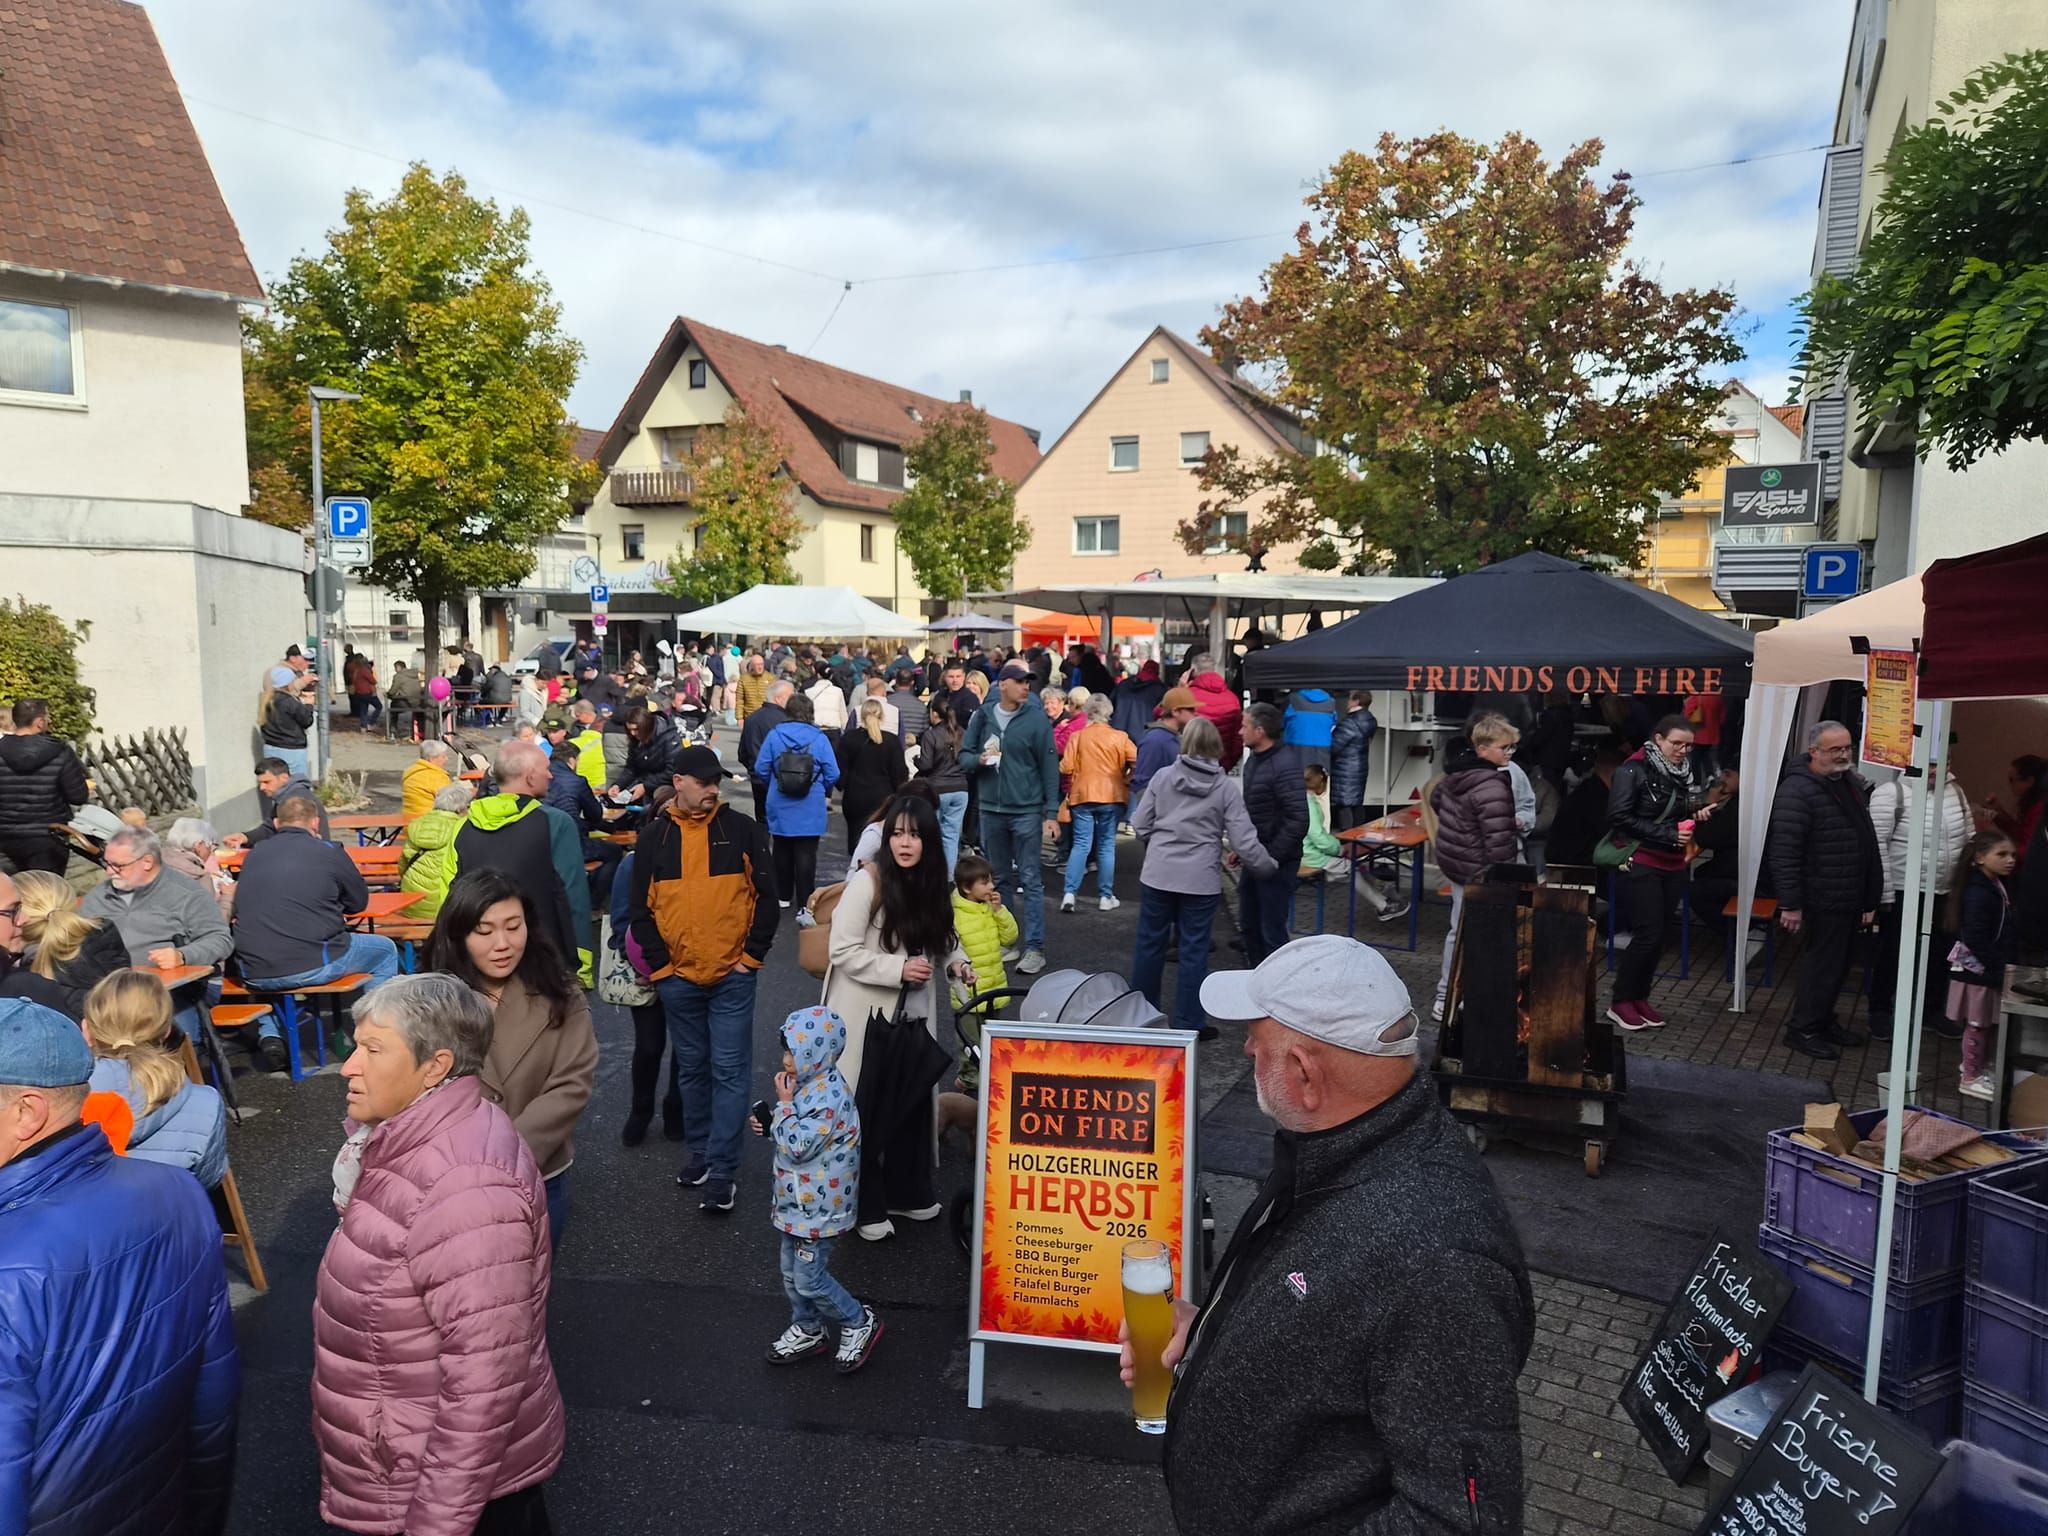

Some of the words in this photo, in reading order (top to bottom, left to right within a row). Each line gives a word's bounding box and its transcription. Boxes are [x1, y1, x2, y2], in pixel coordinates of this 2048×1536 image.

[1732, 488, 1808, 513] EASY
[1756, 503, 1806, 519] Sports
[338, 505, 359, 533] P
[1817, 555, 1847, 590] P
[594, 587, 605, 601] P
[1405, 665, 1554, 694] FRIENDS
[1566, 665, 1621, 695] ON
[1634, 667, 1725, 695] FIRE
[1020, 1085, 1151, 1114] FRIENDS
[1019, 1112, 1065, 1136] ON
[1076, 1116, 1149, 1142] FIRE
[1008, 1153, 1159, 1180] HOLZGERLINGER
[1008, 1174, 1160, 1231] HERBST
[1015, 1221, 1064, 1235] Pommes
[1106, 1222, 1147, 1238] 2026
[1015, 1235, 1094, 1252] Cheeseburger
[1015, 1250, 1040, 1262] BBQ
[1043, 1252, 1081, 1266] Burger
[1014, 1263, 1059, 1277] Chicken
[1062, 1266, 1099, 1282] Burger
[1704, 1243, 1768, 1319] Frischer
[1013, 1291, 1080, 1308] Flammlachs
[1014, 1278, 1051, 1291] Falafel
[1053, 1281, 1092, 1296] Burger
[1685, 1275, 1753, 1357] Flammlachs
[1637, 1360, 1657, 1400] Hier
[1801, 1391, 1898, 1488] Frische
[1737, 1499, 1766, 1534] BBQ
